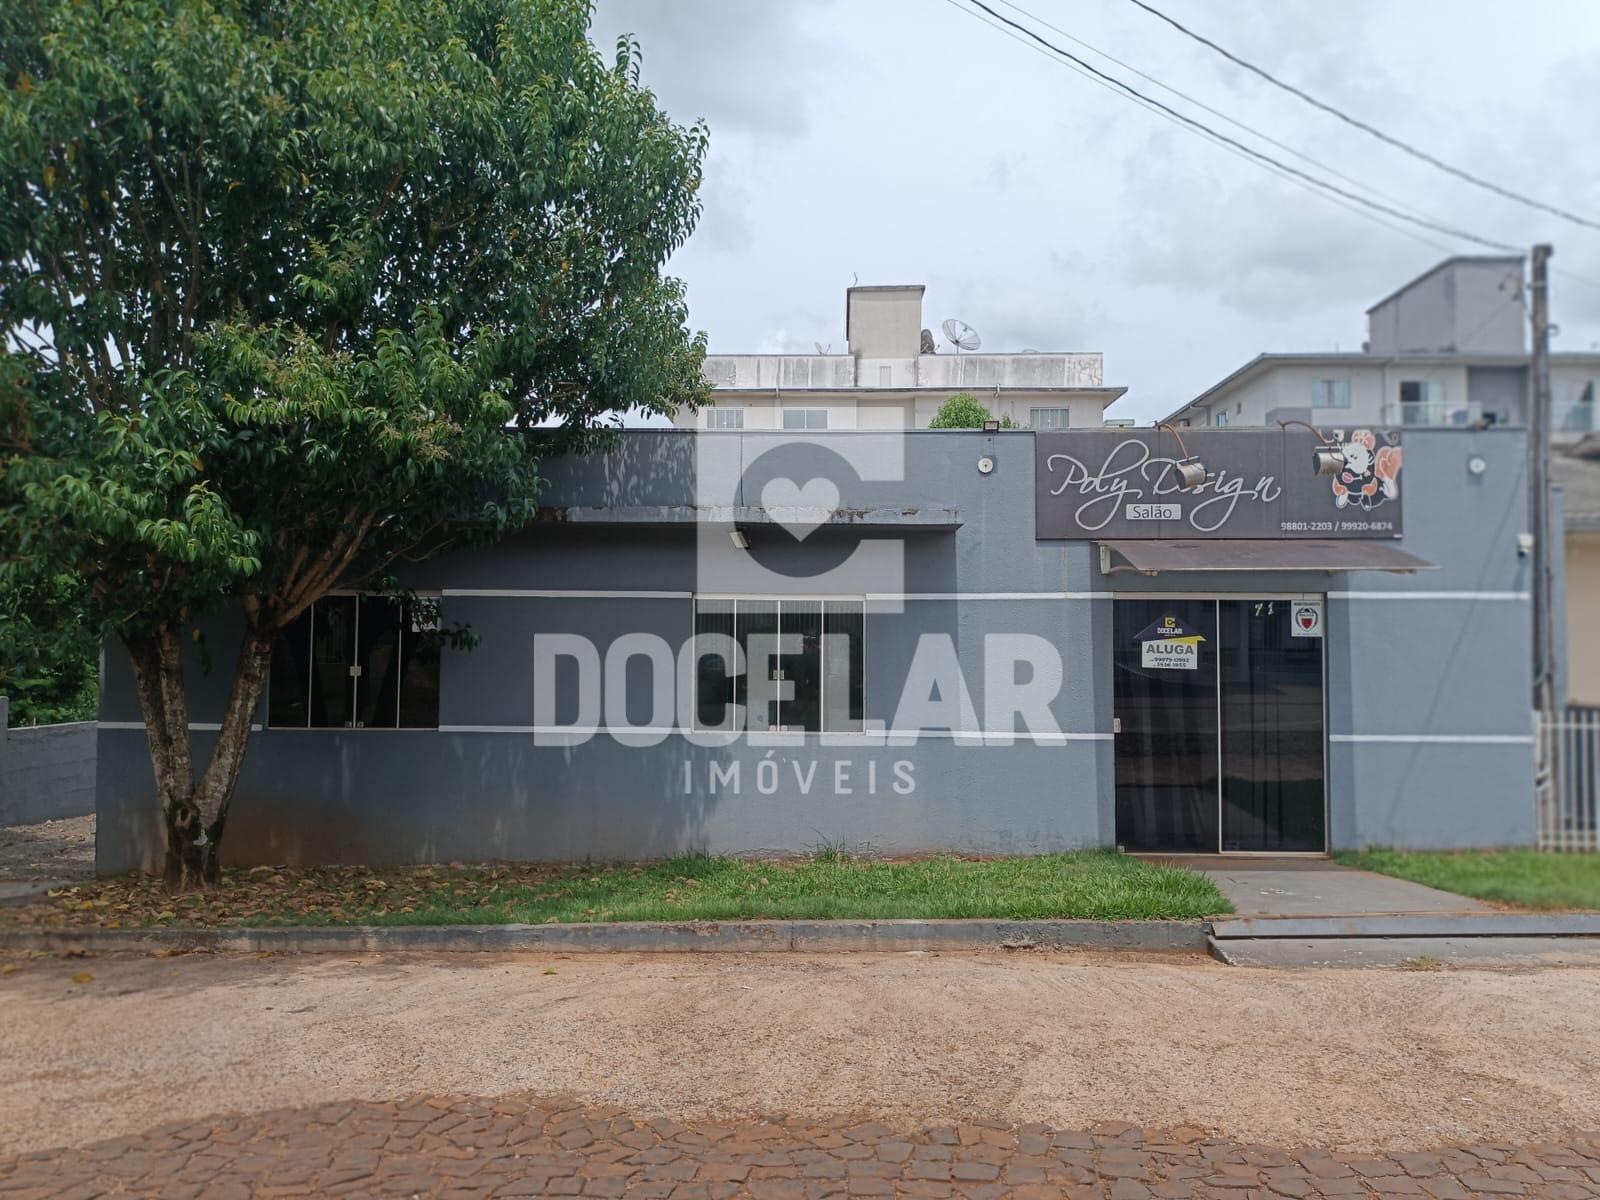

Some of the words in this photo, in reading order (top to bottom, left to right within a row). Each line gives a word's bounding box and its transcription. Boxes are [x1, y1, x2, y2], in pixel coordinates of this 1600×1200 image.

[1047, 439, 1149, 530] Poly
[1141, 457, 1281, 532] Dsign
[1133, 505, 1173, 519] Salão
[1280, 522, 1333, 531] 98801-2203
[1341, 522, 1393, 531] 99920-6874
[1146, 643, 1194, 655] ALUGA
